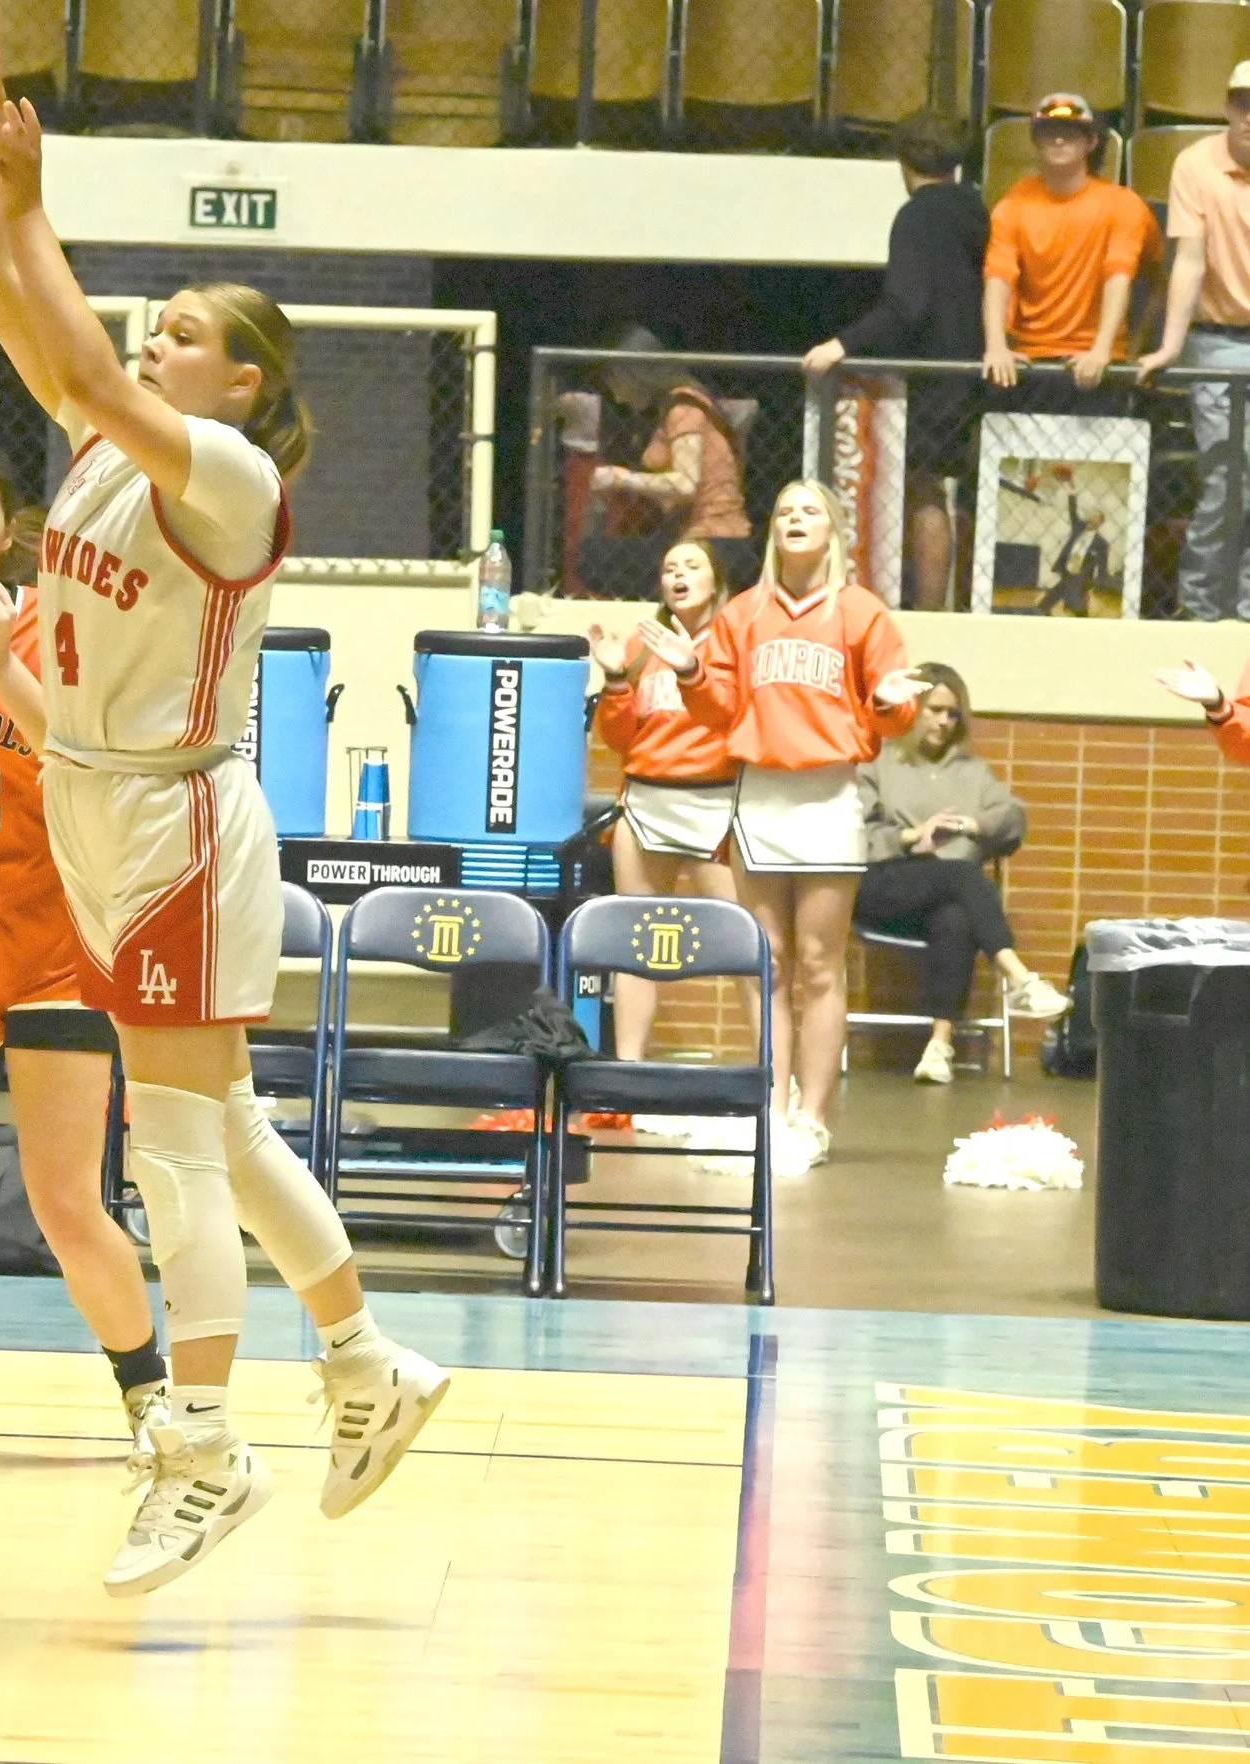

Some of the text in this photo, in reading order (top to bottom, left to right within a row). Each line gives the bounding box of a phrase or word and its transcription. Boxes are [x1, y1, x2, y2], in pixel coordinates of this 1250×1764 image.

[194, 190, 273, 227] EXIT
[38, 527, 150, 612] WNDES
[53, 610, 80, 688] 4
[489, 668, 519, 825] POWERADE
[310, 863, 441, 884] POWER THROUGH
[137, 948, 178, 1005] LA
[875, 1384, 1250, 1764] TGOMERY
